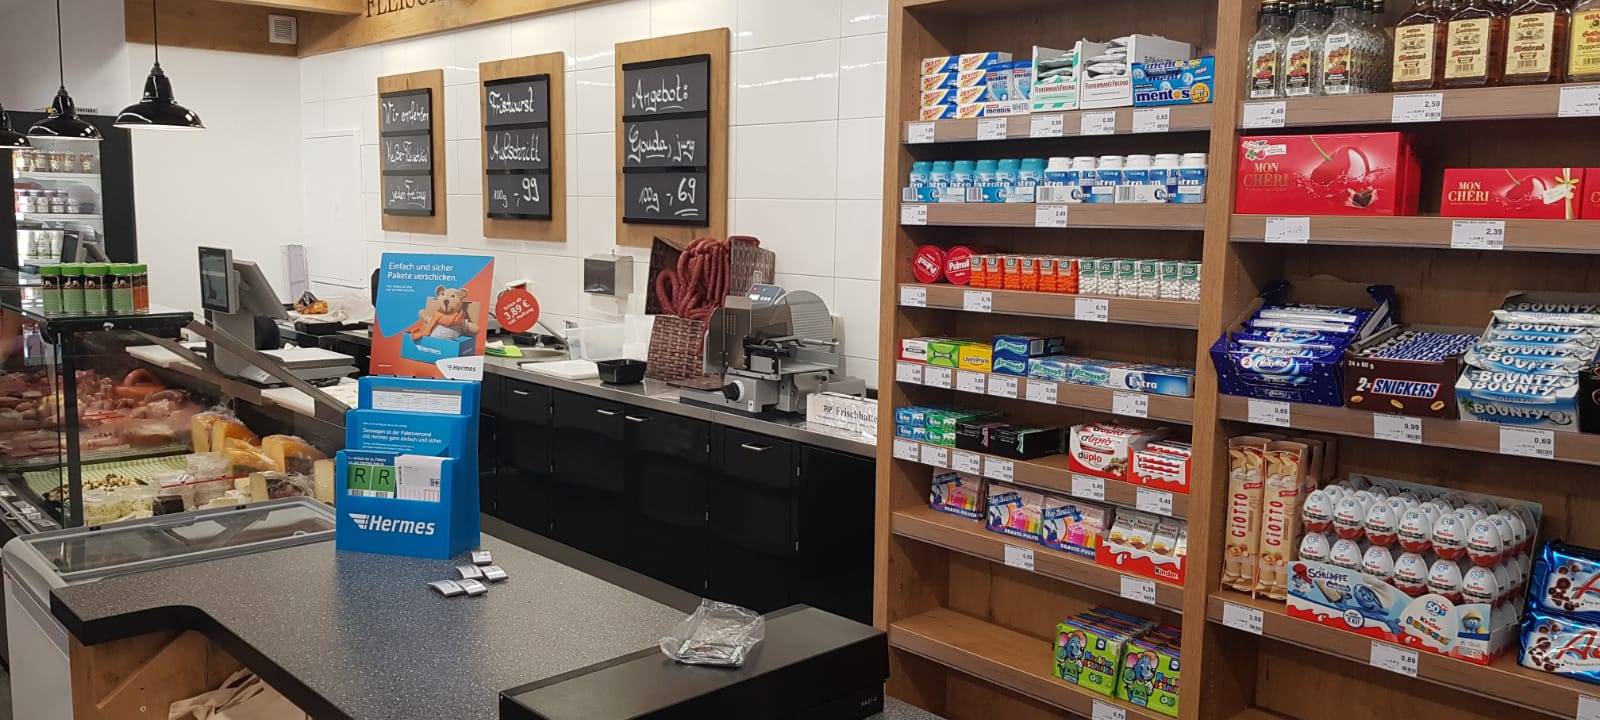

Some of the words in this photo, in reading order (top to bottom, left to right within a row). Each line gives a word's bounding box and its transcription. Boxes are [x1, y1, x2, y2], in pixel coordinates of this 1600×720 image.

[631, 75, 689, 112] Angebot:
[1135, 88, 1190, 101] mentos
[985, 106, 1011, 114] mentos
[1254, 162, 1280, 172] MON
[1458, 181, 1481, 190] MON
[1486, 228, 1503, 236] 2,39
[388, 261, 415, 271] Einfach
[416, 263, 431, 271] und
[431, 263, 454, 273] sicher
[386, 271, 412, 280] Pakete
[414, 273, 457, 282] verschicken.
[522, 299, 531, 308] €
[452, 365, 477, 373] Hermes
[1479, 371, 1561, 386] BOUNTY
[1374, 379, 1439, 399] SNICKERS
[1473, 382, 1556, 397] BOUNTY
[1474, 403, 1549, 419] BOUNTY
[1534, 437, 1552, 445] 0,69
[1079, 448, 1104, 460] duplo
[354, 467, 367, 484] R
[378, 469, 391, 486] R
[369, 514, 437, 536] Hermes
